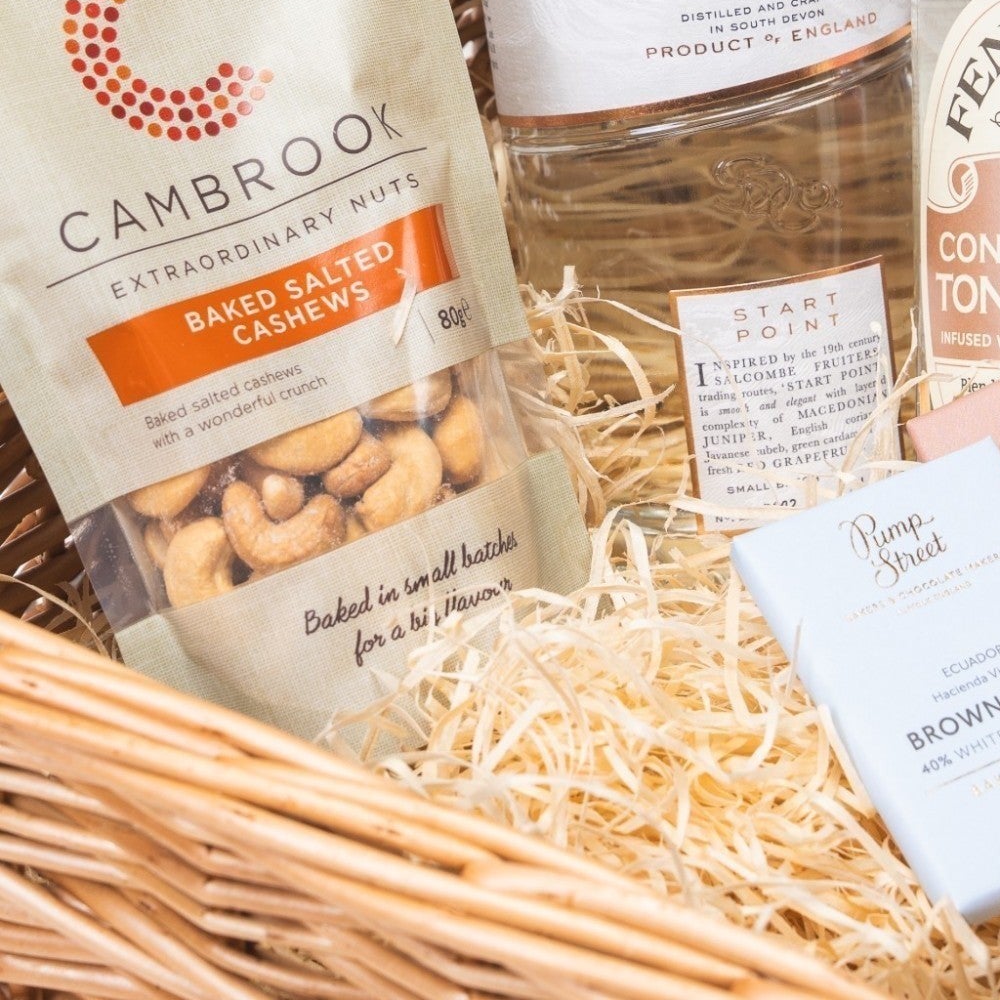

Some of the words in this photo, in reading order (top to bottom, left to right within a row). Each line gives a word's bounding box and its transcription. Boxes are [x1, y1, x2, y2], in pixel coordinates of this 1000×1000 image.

[681, 5, 752, 23] DISTILLED
[757, 1, 785, 14] AND
[710, 24, 724, 34] IN
[730, 16, 777, 33] SOUTH
[781, 7, 825, 26] DEVON
[645, 36, 755, 59] PRODUCT
[792, 12, 878, 43] ENGLAND
[59, 103, 403, 253] CAMBROOK
[111, 208, 336, 299] EXTRAORDINARY
[351, 172, 421, 214] NUTS
[185, 288, 277, 334] BAKED
[284, 241, 395, 300] SALTED
[232, 280, 370, 346] CASHEWS
[734, 292, 837, 322] START
[737, 313, 840, 342] POINT
[941, 331, 991, 348] INFUSED
[784, 352, 795, 363] by
[802, 349, 817, 359] the
[823, 343, 844, 355] 19th
[144, 408, 187, 432] Baked
[192, 386, 240, 415] salted
[243, 364, 303, 395] cashews
[699, 390, 736, 402] trading
[701, 408, 708, 417] is
[760, 402, 776, 411] and
[786, 395, 816, 407] elegant
[826, 389, 846, 399] with
[152, 431, 180, 450] with
[184, 427, 195, 439] a
[198, 393, 278, 433] wonderful
[279, 374, 328, 402] crunch
[773, 414, 783, 424] of
[791, 422, 828, 436] English
[792, 440, 820, 452] green
[707, 466, 732, 475] fresh
[727, 483, 770, 494] SMALL
[838, 512, 935, 559] Pump
[871, 531, 947, 589] Street
[304, 585, 373, 635] Baked
[378, 585, 399, 606] in
[405, 550, 457, 595] small
[462, 528, 518, 568] batches
[354, 628, 386, 667] for
[391, 625, 405, 640] a
[932, 674, 988, 703] Hacienda
[921, 754, 953, 775] 40%
